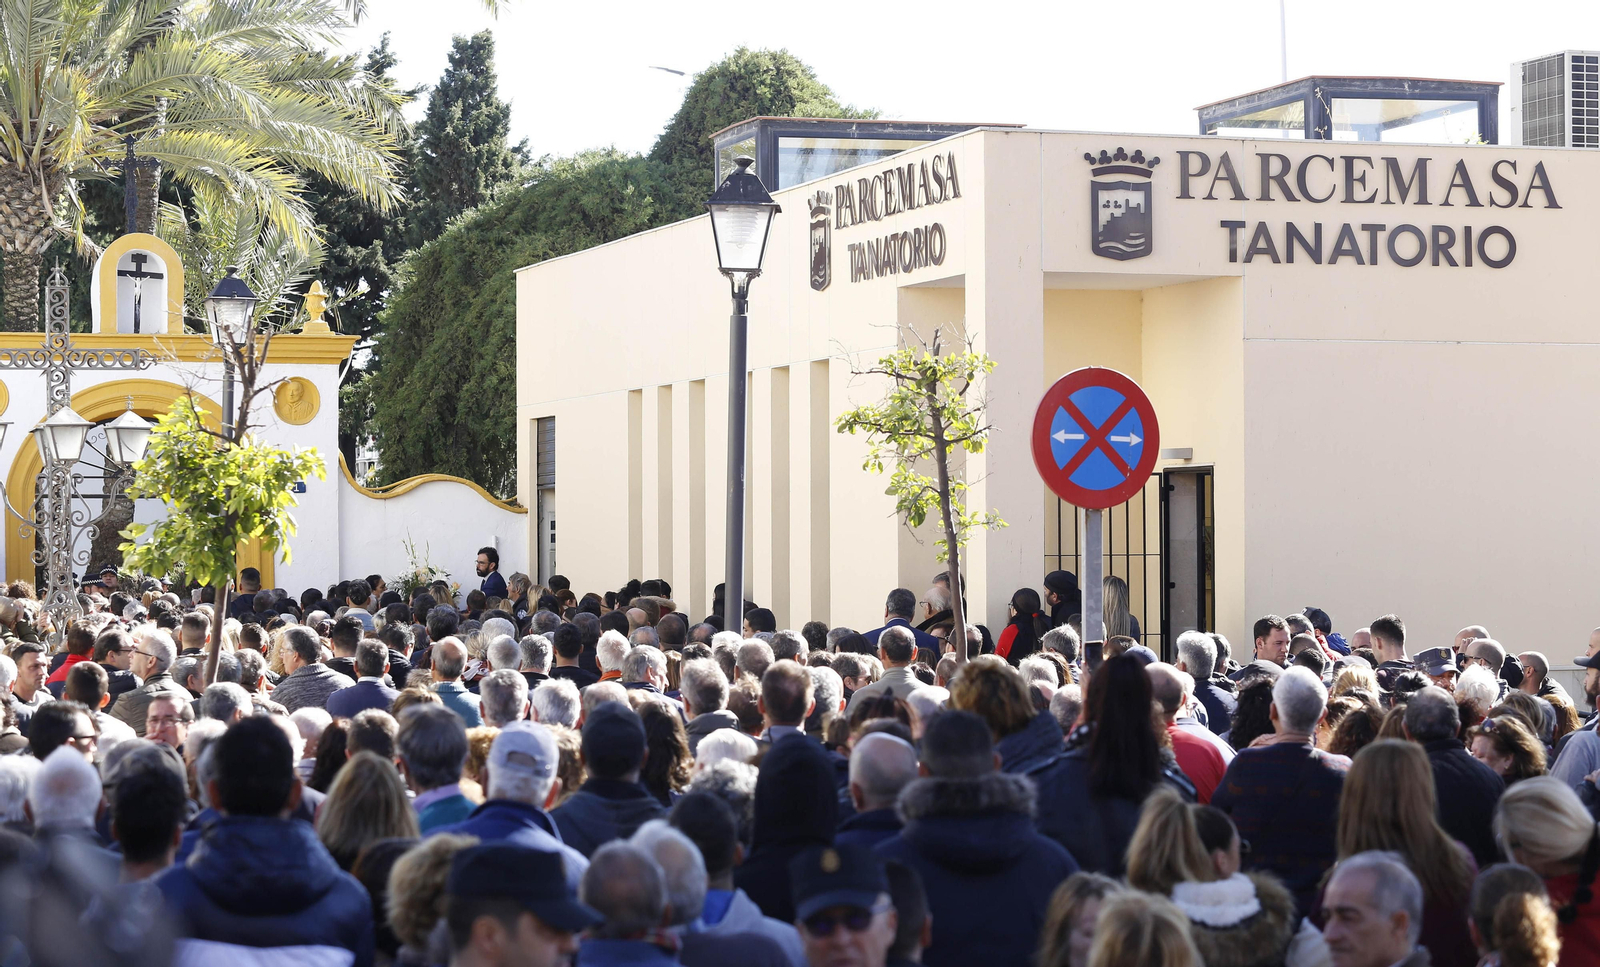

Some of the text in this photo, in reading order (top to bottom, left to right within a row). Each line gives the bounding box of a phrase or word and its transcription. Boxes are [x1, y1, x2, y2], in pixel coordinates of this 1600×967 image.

[835, 151, 962, 229] PARCEMASA
[1176, 150, 1563, 209] PARCEMASA
[848, 223, 946, 282] TANATORIO
[1221, 221, 1517, 268] TANATORIO
